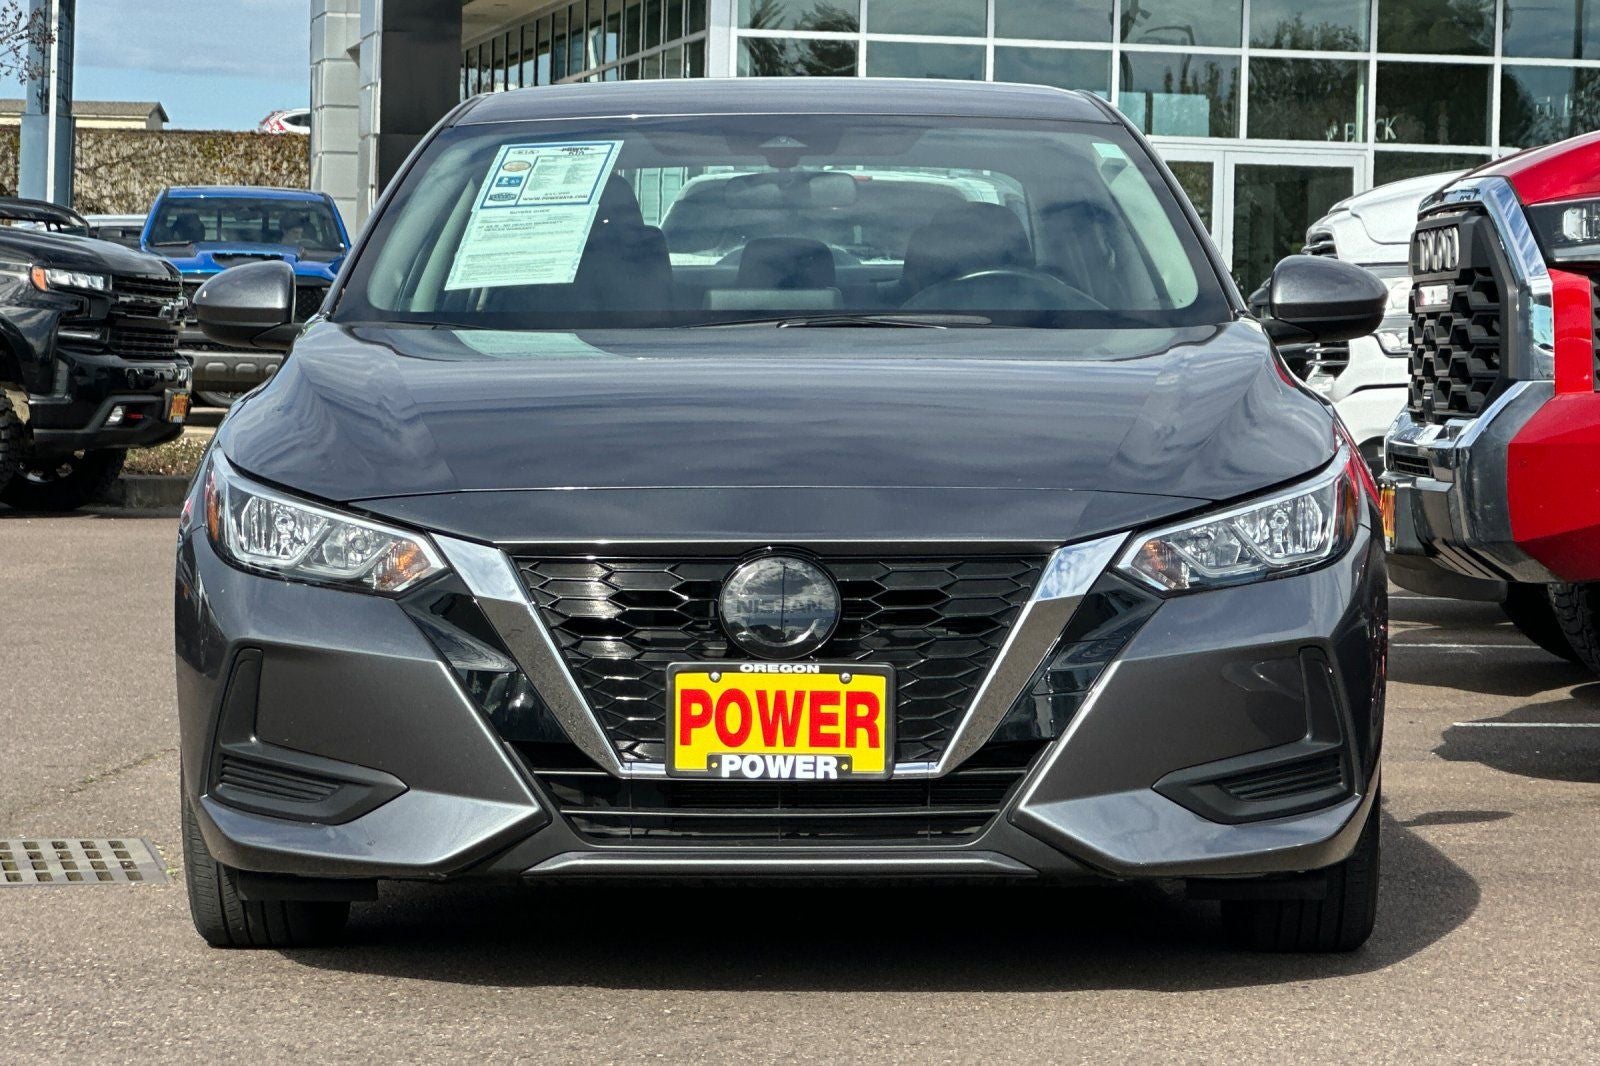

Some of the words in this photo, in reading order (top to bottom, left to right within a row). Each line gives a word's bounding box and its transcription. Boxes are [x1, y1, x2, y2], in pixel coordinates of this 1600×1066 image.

[740, 664, 820, 674] OREGON
[680, 688, 881, 748] POWER
[721, 755, 838, 780] POWER
